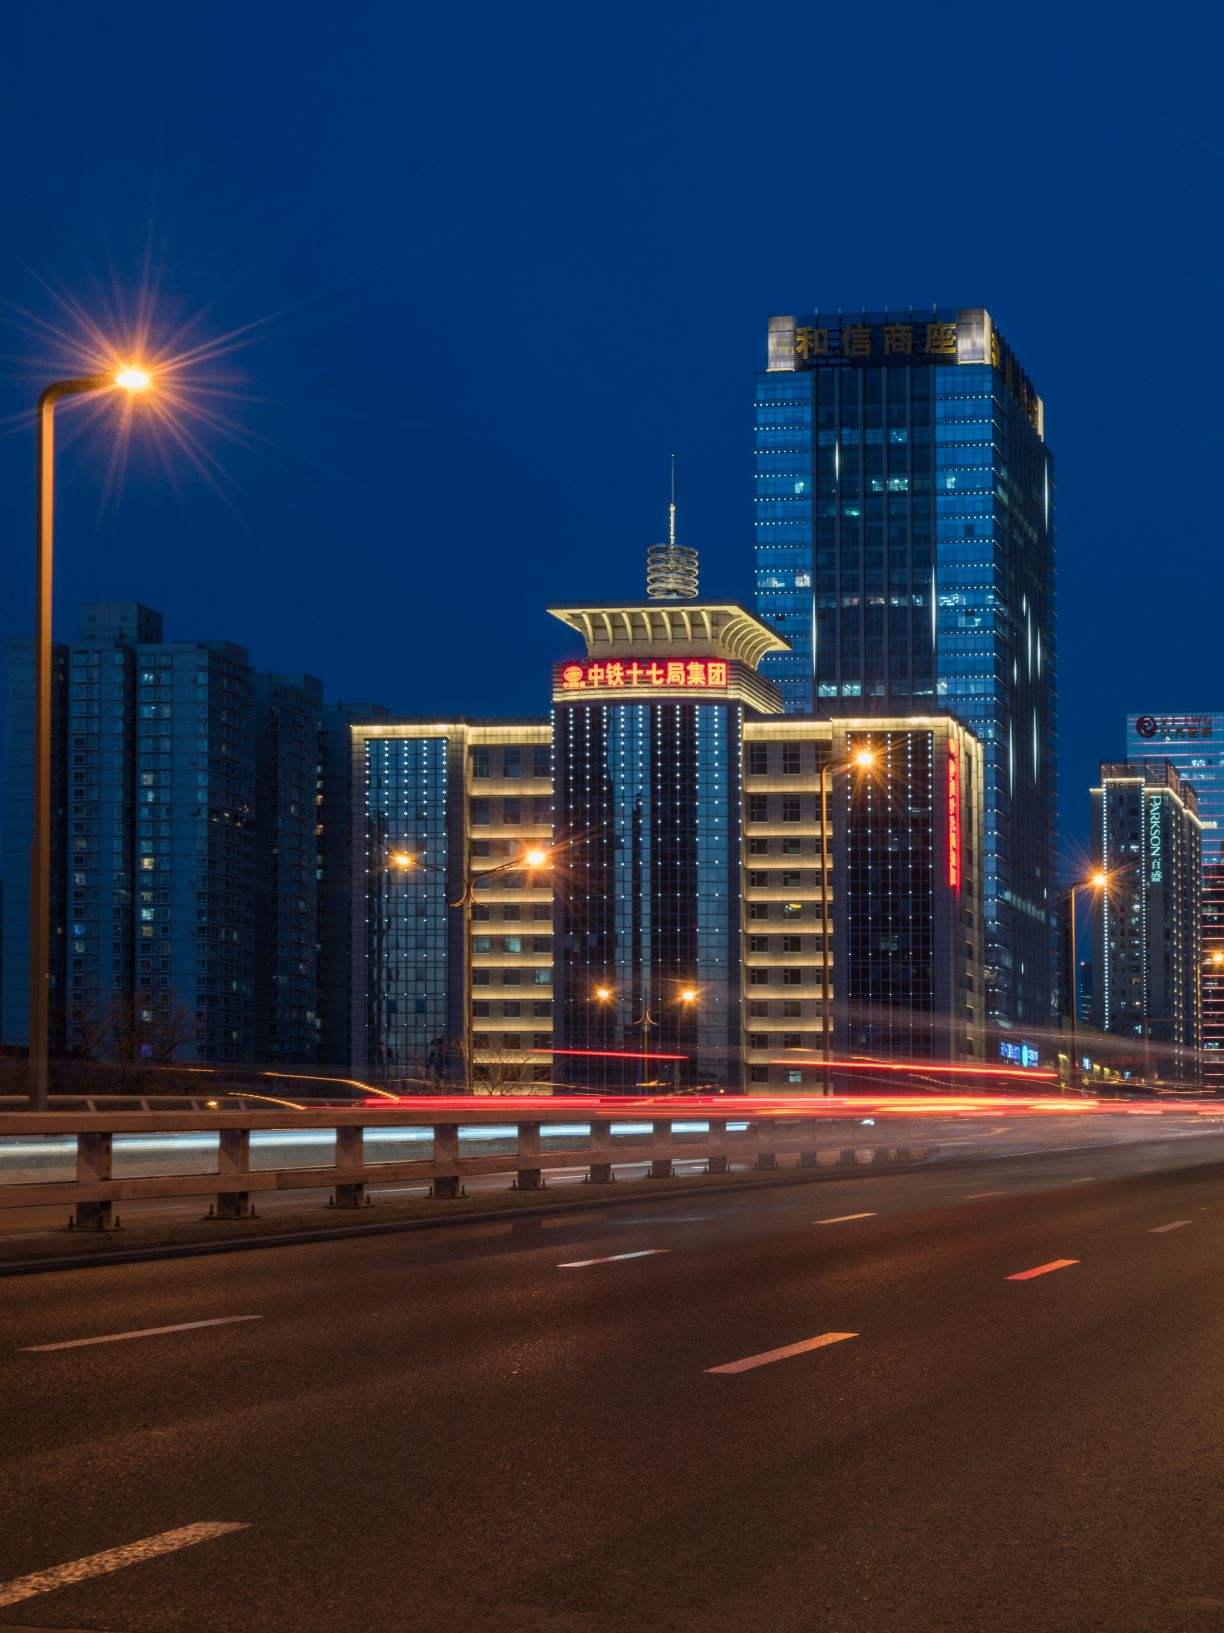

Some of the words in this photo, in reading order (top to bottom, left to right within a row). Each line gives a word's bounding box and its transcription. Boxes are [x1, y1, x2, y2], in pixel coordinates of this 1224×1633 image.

[587, 661, 727, 687] 中铁十七局集团
[1149, 795, 1162, 857] PARKSON
